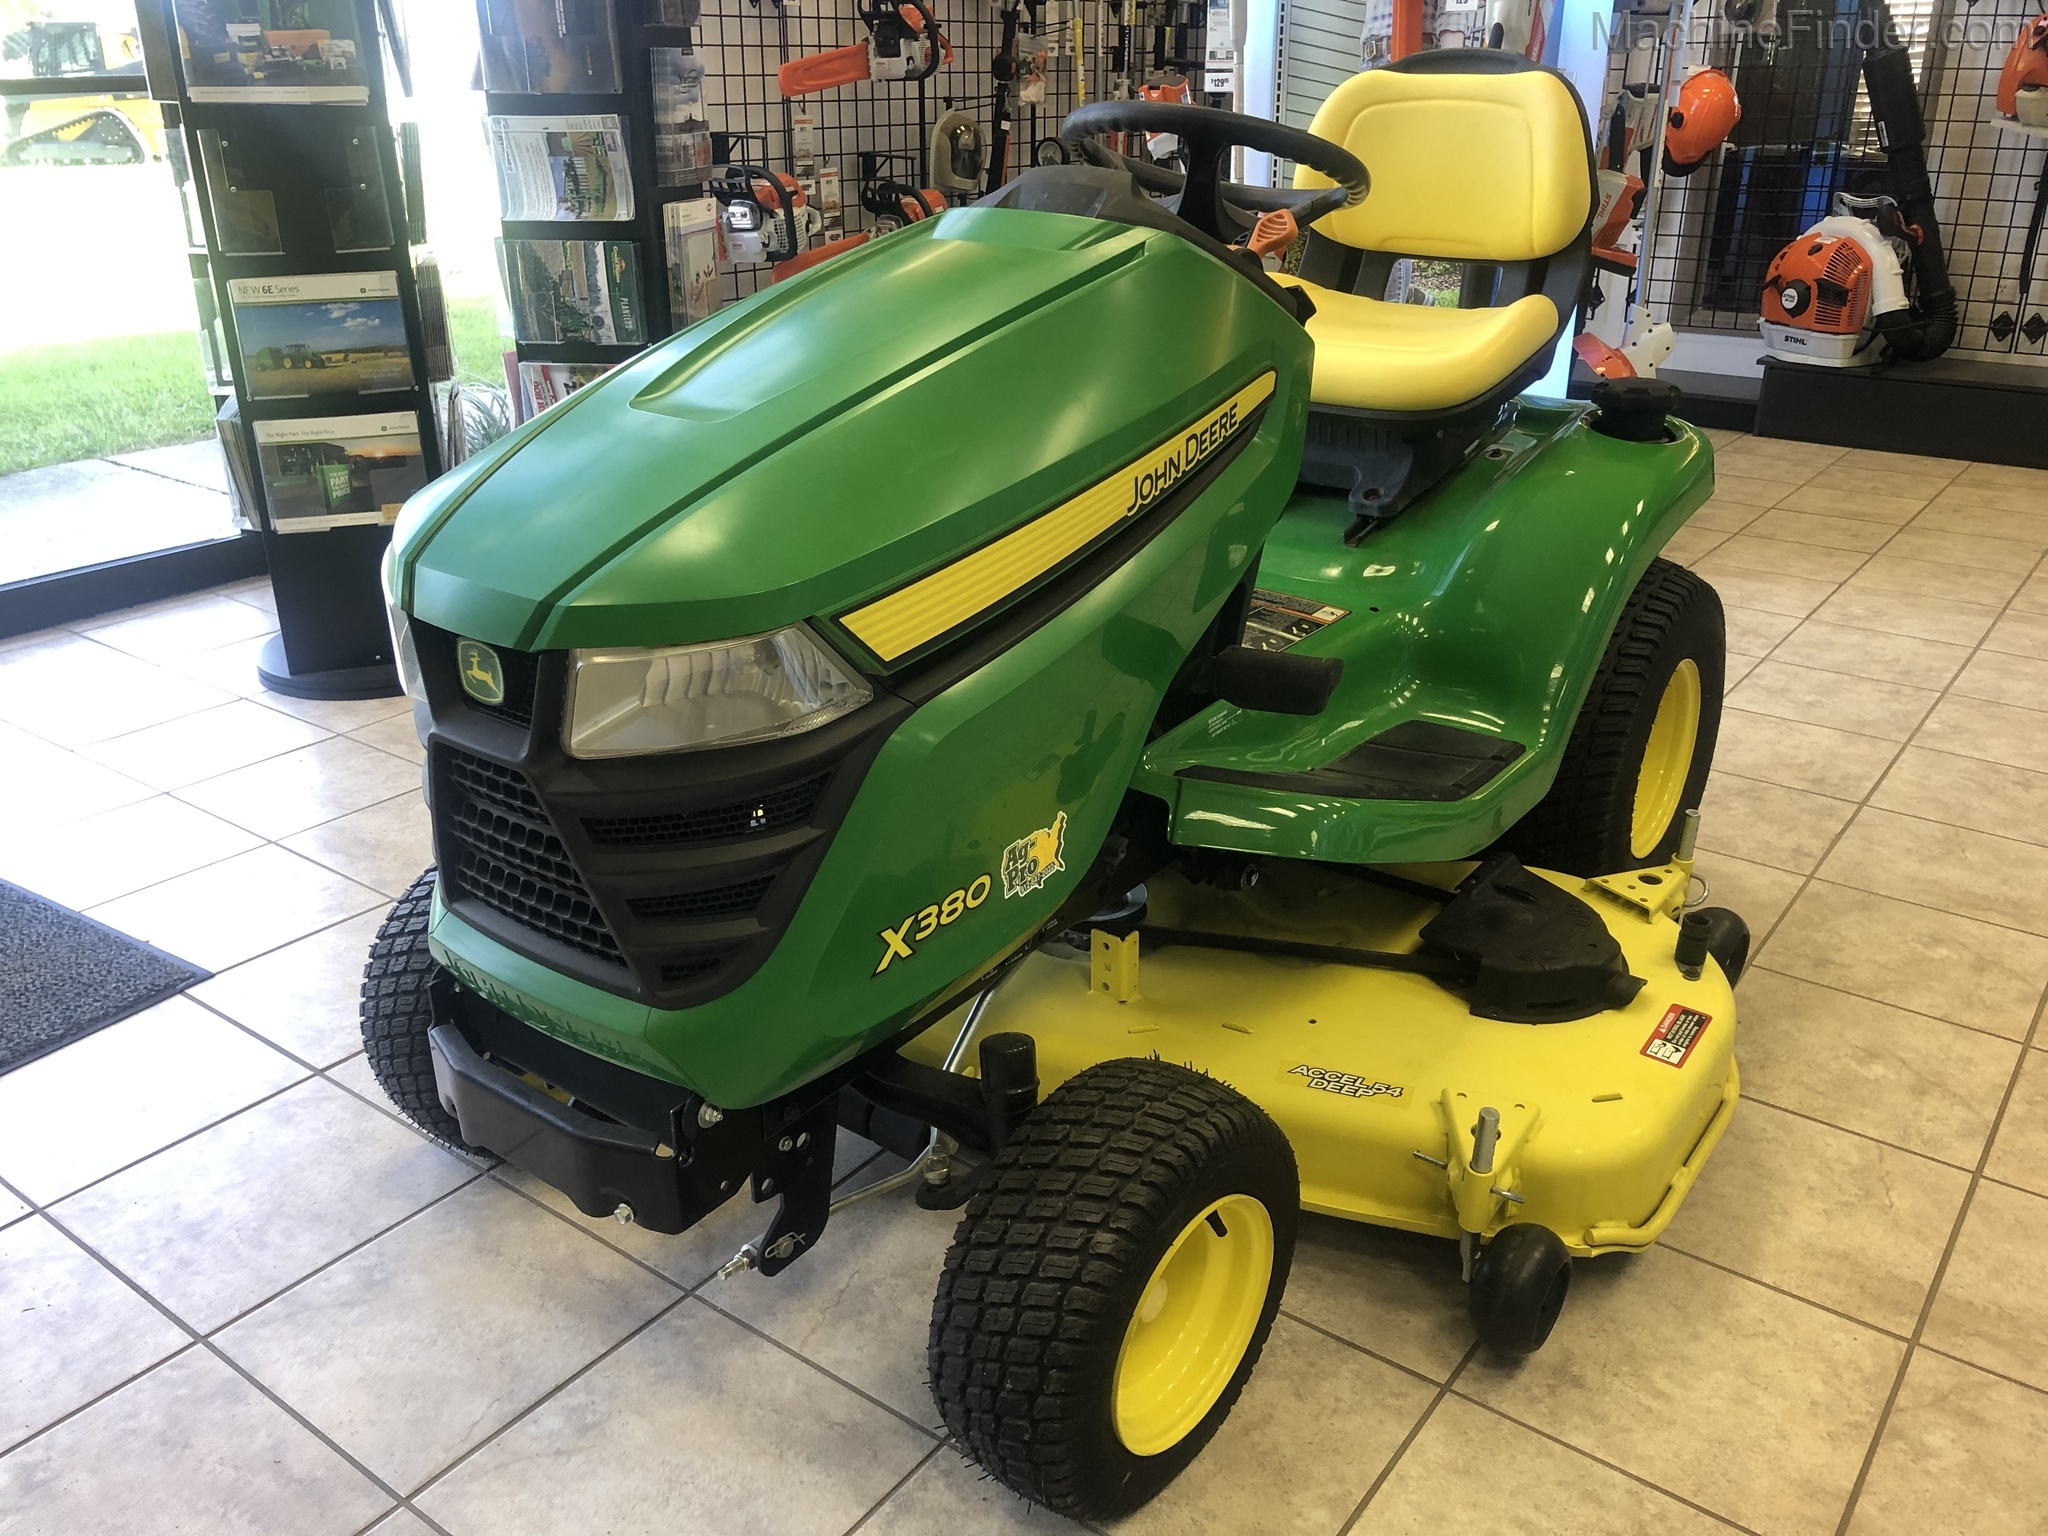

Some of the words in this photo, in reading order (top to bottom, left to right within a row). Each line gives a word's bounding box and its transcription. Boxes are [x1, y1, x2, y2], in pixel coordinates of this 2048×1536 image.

[1596, 192, 1612, 219] STIHL
[261, 285, 274, 294] 6E
[275, 284, 300, 294] Series
[620, 297, 634, 329] PLANTERS
[1784, 334, 1808, 346] STIHL
[1127, 450, 1182, 516] JOHN
[1184, 402, 1238, 468] DEERE
[330, 475, 349, 487] PART
[1007, 857, 1038, 893] Pro
[870, 873, 993, 980] X380
[1661, 1012, 1676, 1029] DANGER
[1288, 1065, 1369, 1089] ACCEL
[1371, 1082, 1404, 1098] 54
[1307, 1078, 1376, 1098] DEEP
